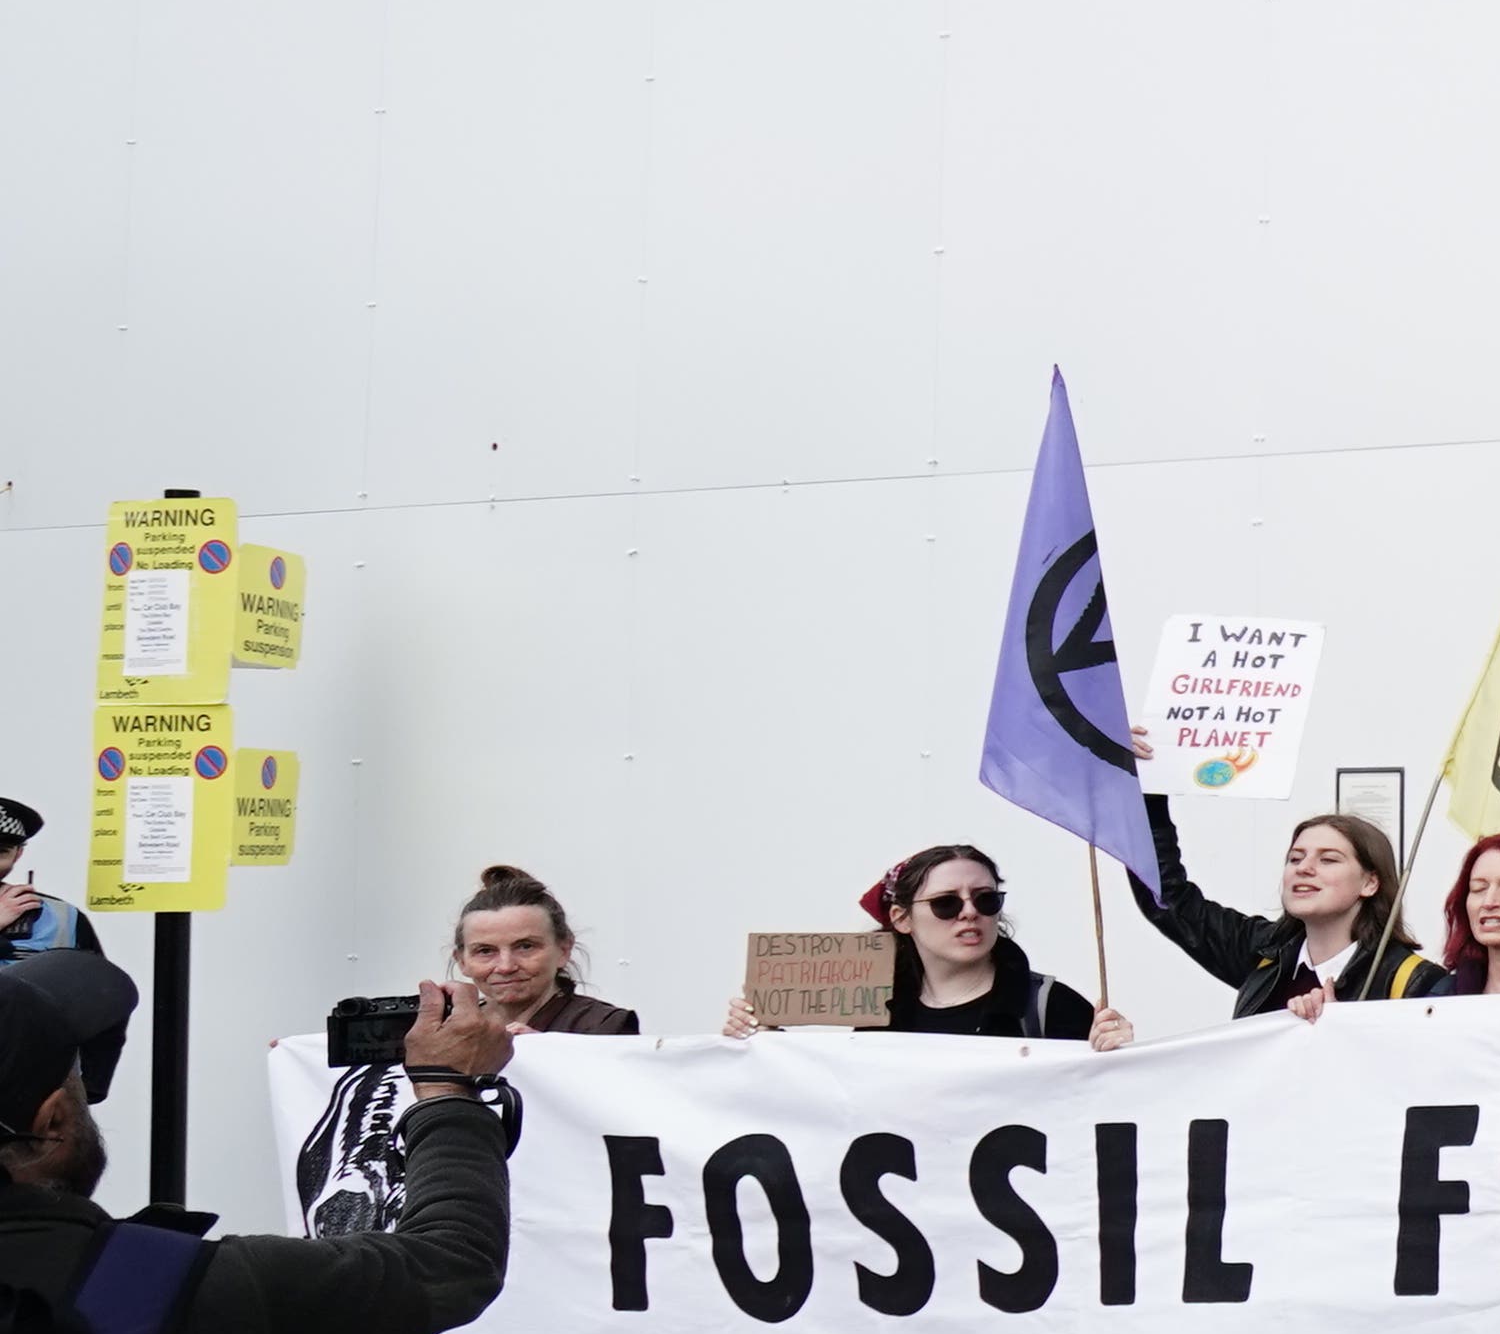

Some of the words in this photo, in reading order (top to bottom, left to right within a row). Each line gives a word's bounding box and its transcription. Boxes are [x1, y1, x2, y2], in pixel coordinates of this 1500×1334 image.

[124, 509, 216, 527] WARNING
[144, 533, 186, 543] Parking
[136, 545, 195, 555] suspended
[136, 561, 149, 570] No
[153, 560, 194, 571] Loading
[242, 593, 299, 622] WARNING
[256, 619, 290, 643] Parking
[1187, 623, 1202, 643] I
[1220, 625, 1307, 647] WANT
[243, 639, 294, 659] suspension
[1202, 650, 1217, 668] A
[1232, 651, 1285, 669] HOT
[99, 689, 140, 699] Lambeth
[1172, 674, 1302, 697] GIRLFRIEND
[1166, 706, 1210, 721] NOT
[1214, 706, 1225, 721] A
[1236, 707, 1282, 723] HOT
[112, 715, 211, 733] WARNING
[138, 737, 182, 749] Parking
[1178, 727, 1272, 747] PLANET
[128, 751, 192, 761] suspended
[128, 767, 144, 776] No
[147, 766, 190, 777] Loading
[236, 797, 292, 818] WARNING
[94, 829, 118, 837] place
[248, 822, 280, 841] Parking
[238, 843, 286, 859] suspension
[90, 895, 134, 906] Lambeth
[756, 935, 844, 957] DESTROY
[855, 935, 884, 952] THE
[758, 960, 873, 985] PATRIARCHY
[752, 989, 794, 1016] NOT
[798, 989, 828, 1015] THE
[830, 986, 892, 1016] PLANET
[603, 1119, 1253, 1323] FOSSIL
